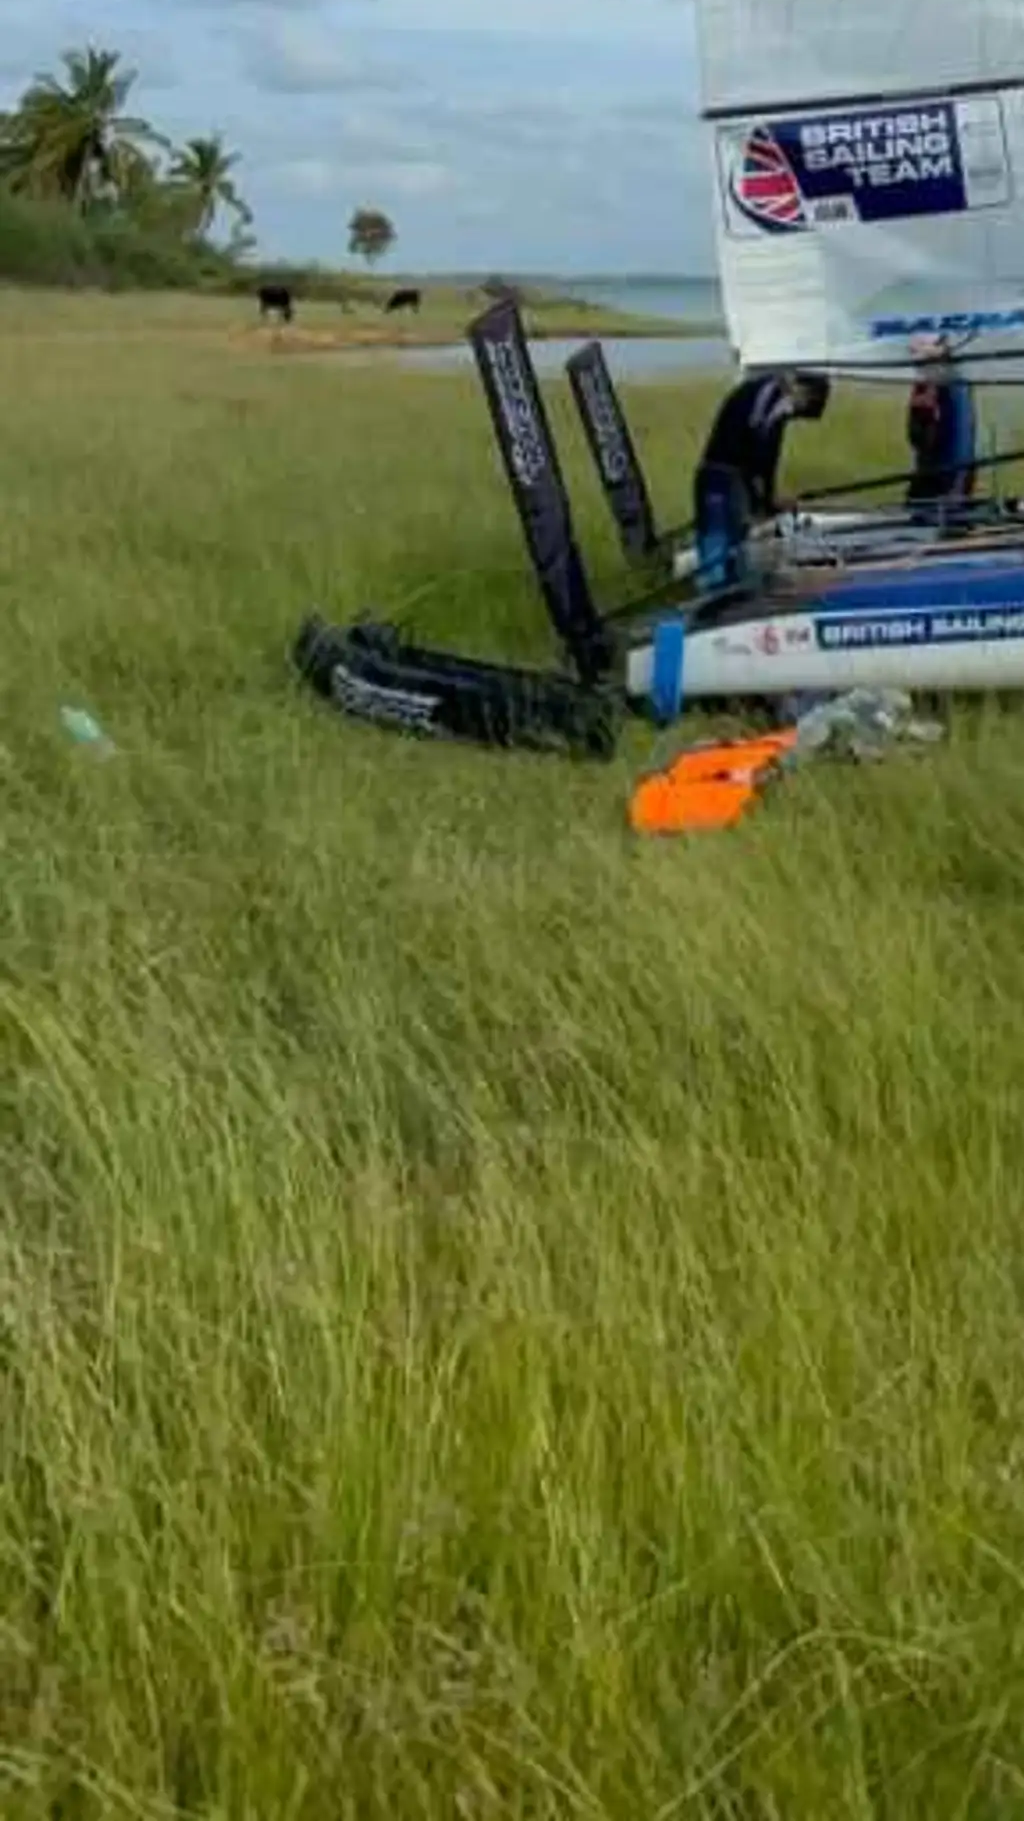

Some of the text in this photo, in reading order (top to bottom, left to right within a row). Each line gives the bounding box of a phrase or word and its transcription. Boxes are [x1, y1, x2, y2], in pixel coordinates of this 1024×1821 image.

[801, 110, 946, 144] BRITISH
[804, 131, 949, 170] SAILING
[844, 158, 951, 187] TEAM
[823, 619, 925, 646] BRITISH
